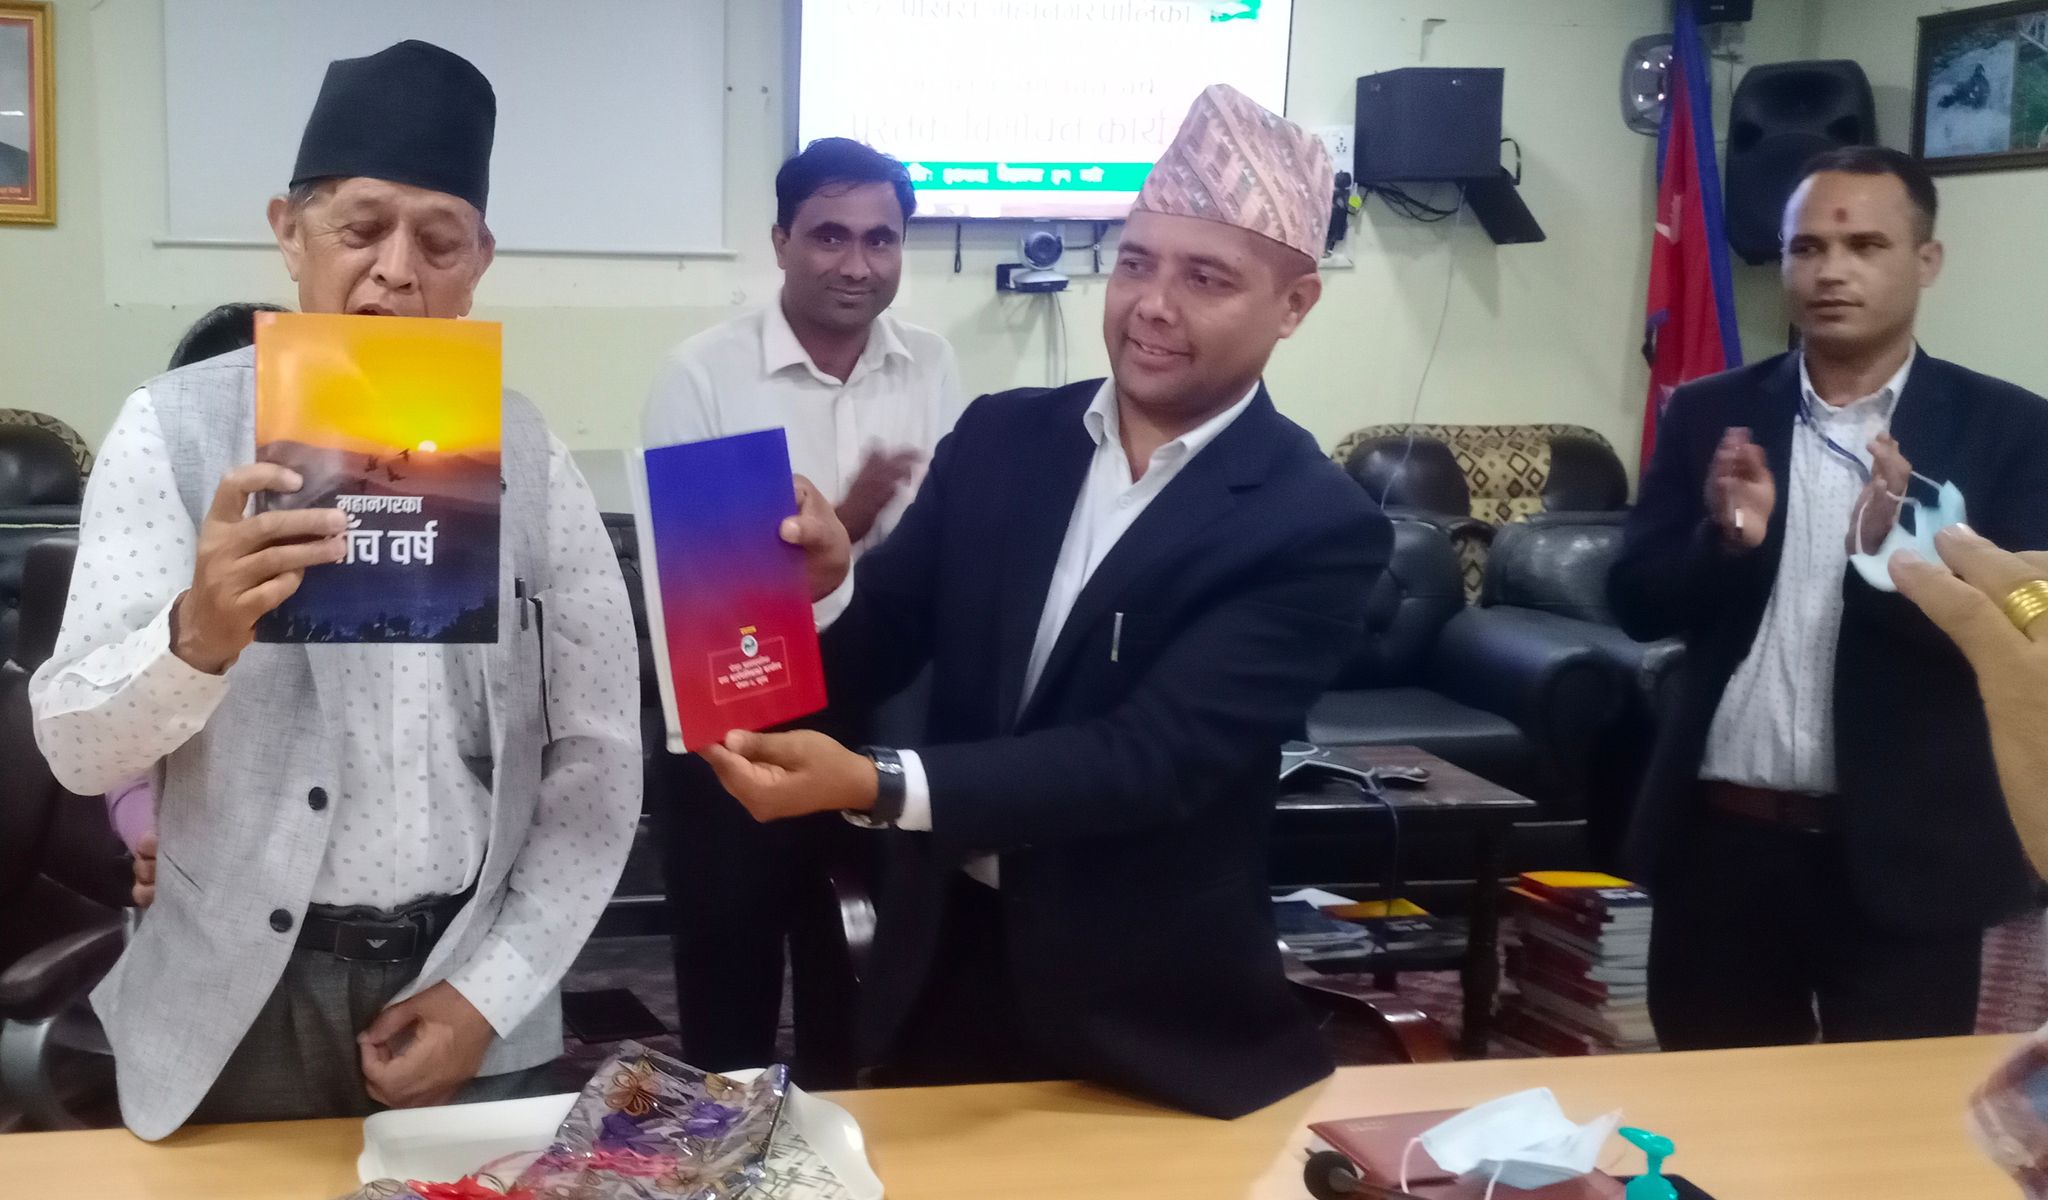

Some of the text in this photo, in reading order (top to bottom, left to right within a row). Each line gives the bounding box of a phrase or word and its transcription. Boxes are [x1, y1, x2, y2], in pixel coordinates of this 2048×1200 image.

[335, 494, 424, 514] महानगरका
[338, 514, 438, 565] ाँच वर्ष
